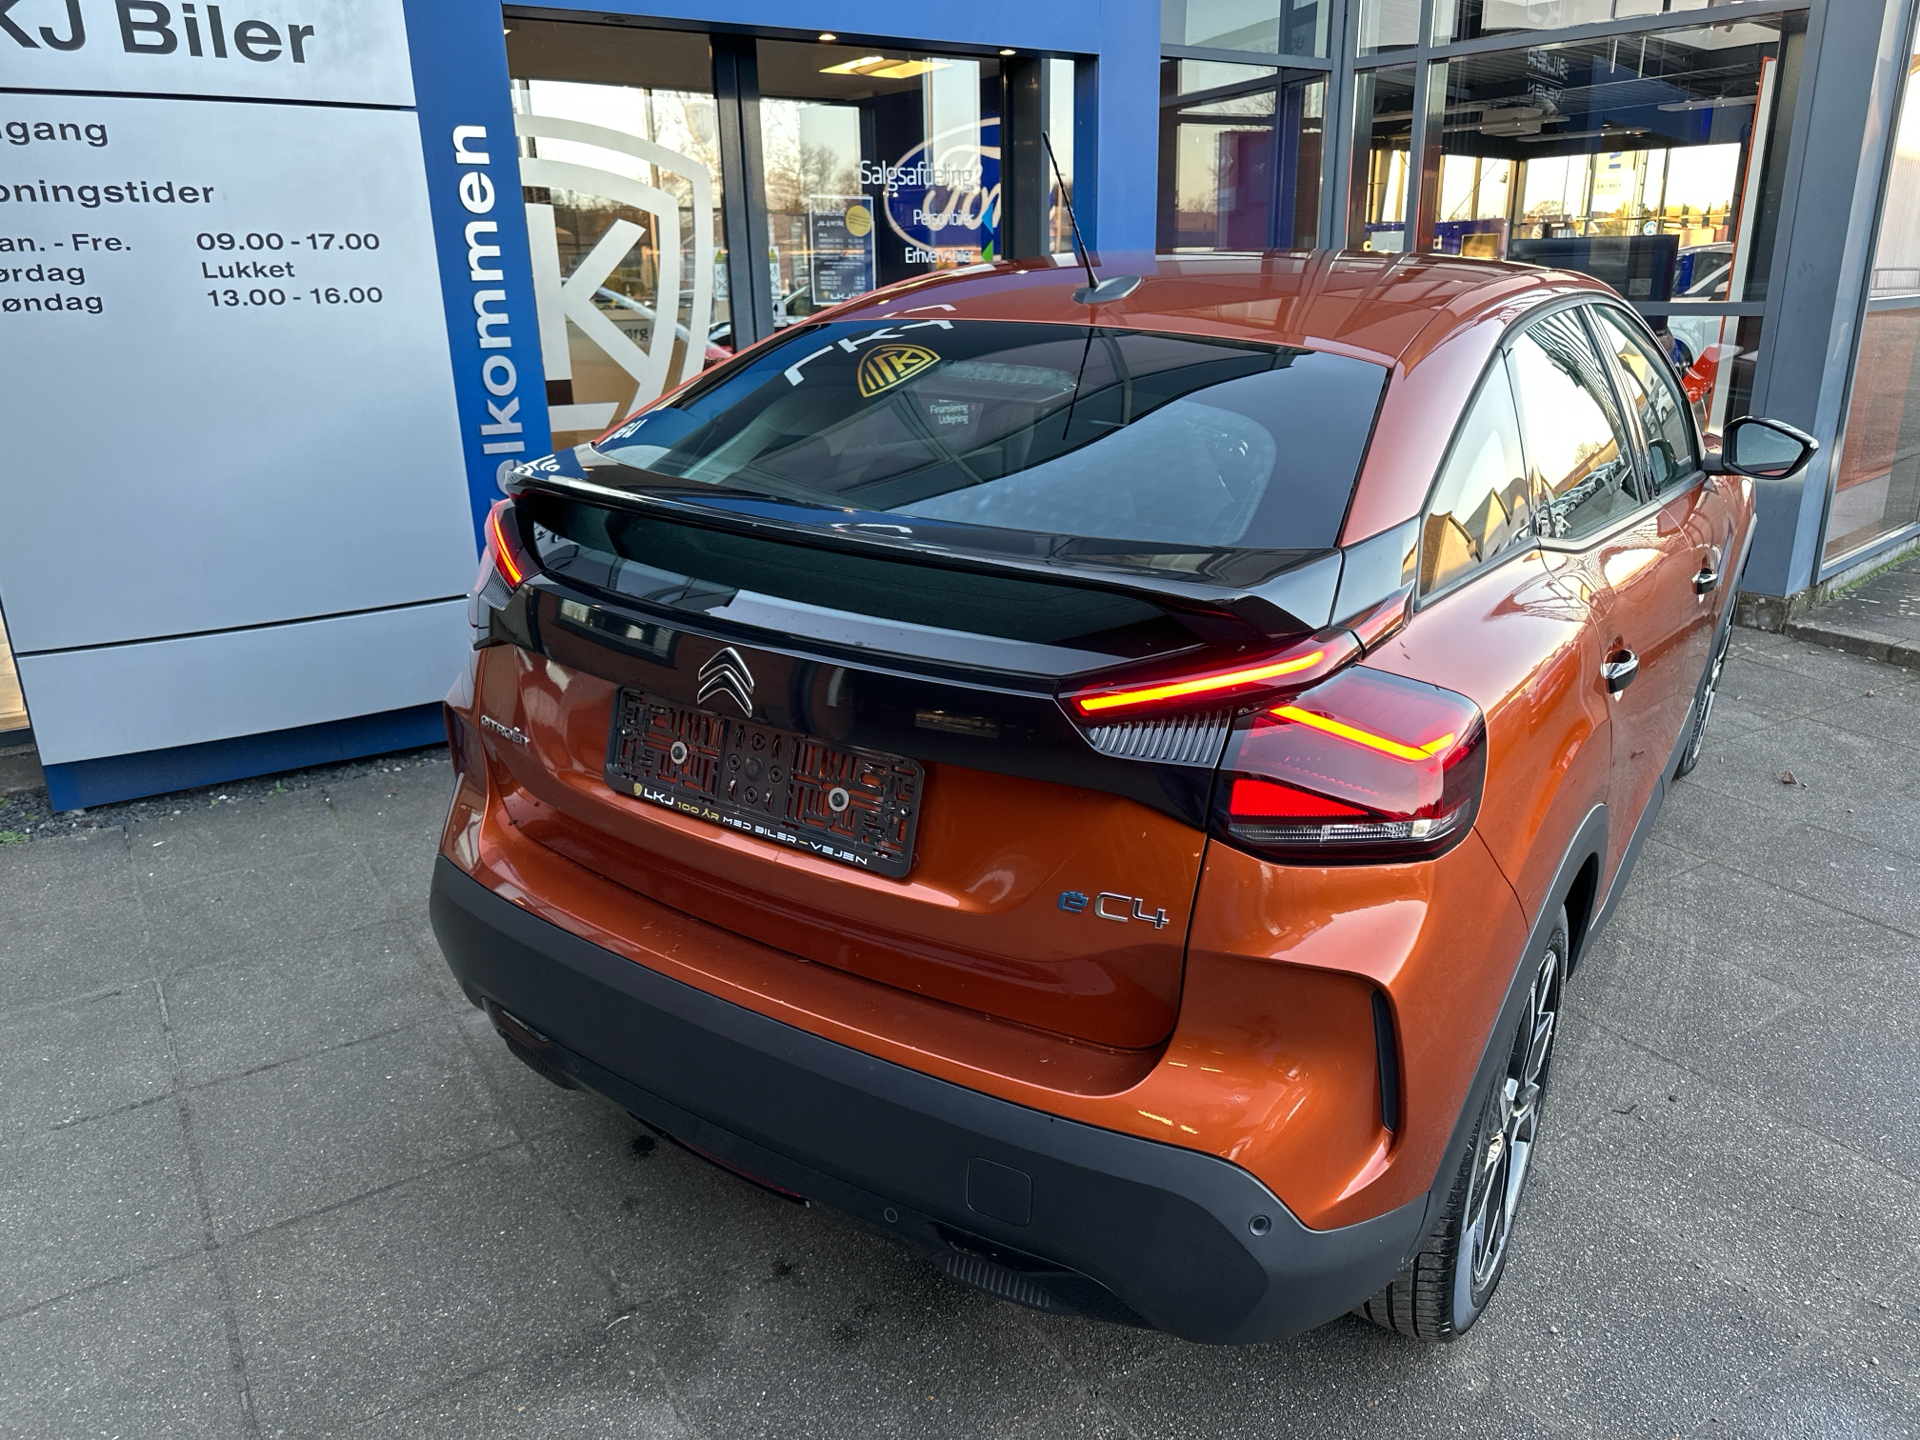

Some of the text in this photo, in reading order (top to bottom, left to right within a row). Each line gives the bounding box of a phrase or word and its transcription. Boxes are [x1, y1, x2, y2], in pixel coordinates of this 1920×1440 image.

[115, 0, 315, 64] Biler
[0, 121, 109, 148] gang
[860, 160, 974, 192] Salgsafdeling
[913, 209, 974, 226] Personbiler
[72, 233, 131, 252] Fre.
[196, 232, 284, 251] 09.00
[306, 233, 380, 250] 17.00
[905, 246, 974, 264] Erhvervsbiler
[0, 261, 295, 285] ørdag Lukket
[2, 293, 104, 314] øndag
[207, 288, 286, 307] 13.00
[310, 287, 383, 304] 16.00
[643, 788, 675, 806] LKJ
[677, 801, 699, 814] 100
[722, 816, 752, 831] MED
